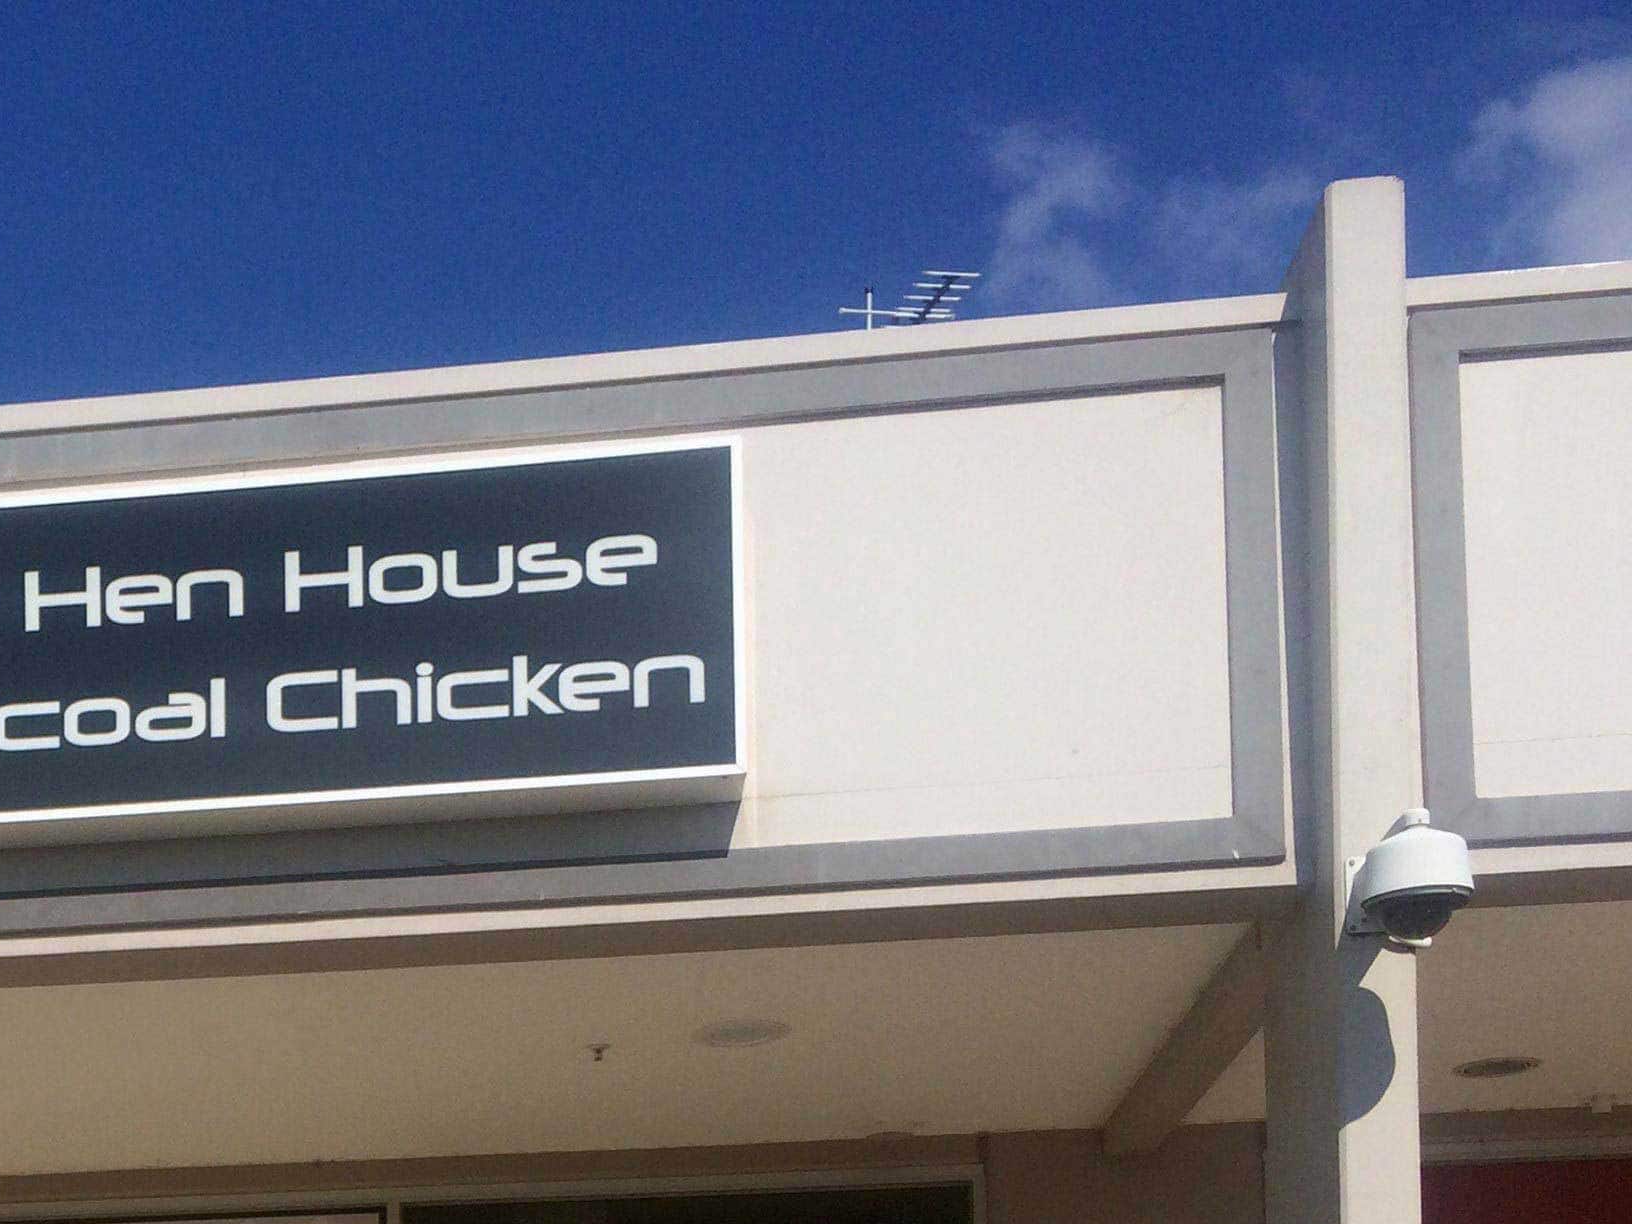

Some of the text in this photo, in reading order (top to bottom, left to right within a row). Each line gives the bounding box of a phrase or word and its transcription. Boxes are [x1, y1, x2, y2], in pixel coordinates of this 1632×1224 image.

[23, 565, 244, 632] Hen
[284, 532, 658, 613] House
[265, 653, 705, 736] Chicken
